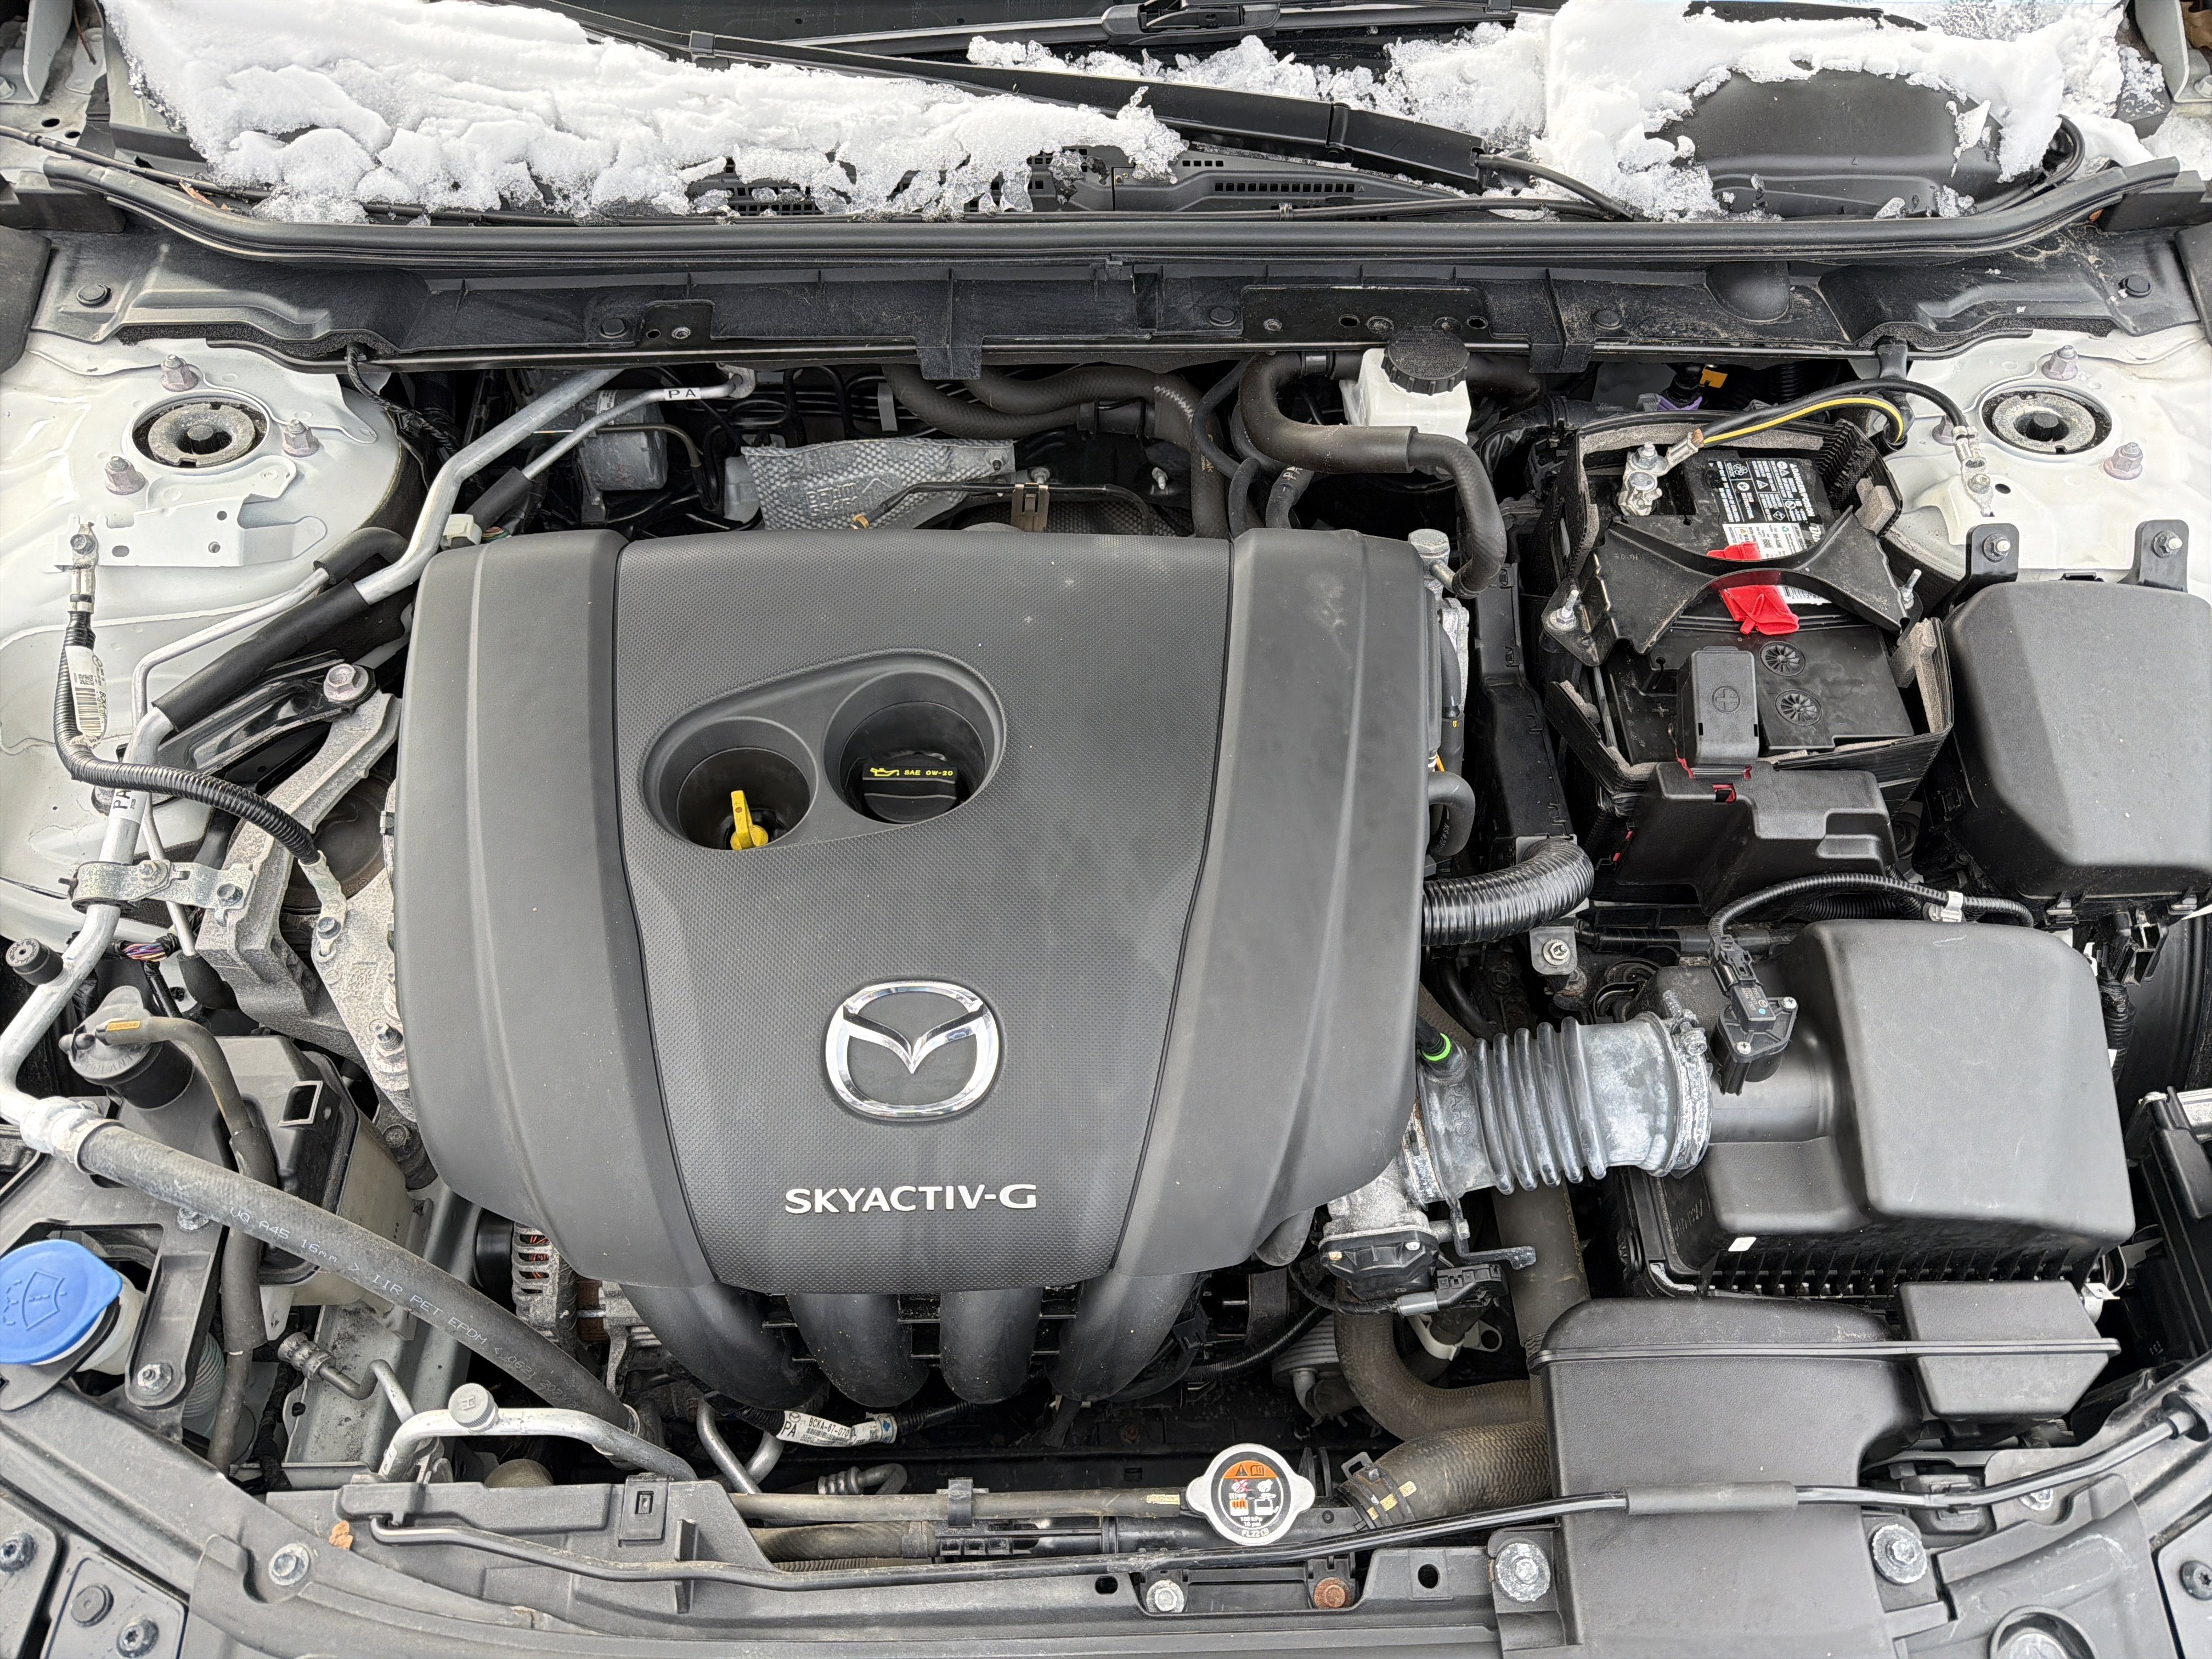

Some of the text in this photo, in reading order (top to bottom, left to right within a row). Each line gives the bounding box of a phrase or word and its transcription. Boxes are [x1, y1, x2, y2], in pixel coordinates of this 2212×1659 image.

[1792, 468, 1815, 517] DANGER/POISON
[785, 1183, 1037, 1214] SKYACTIV-G
[258, 1220, 291, 1240] A45
[300, 1238, 338, 1263] 16mm
[410, 1294, 443, 1317] PET
[780, 1421, 798, 1438] PA
